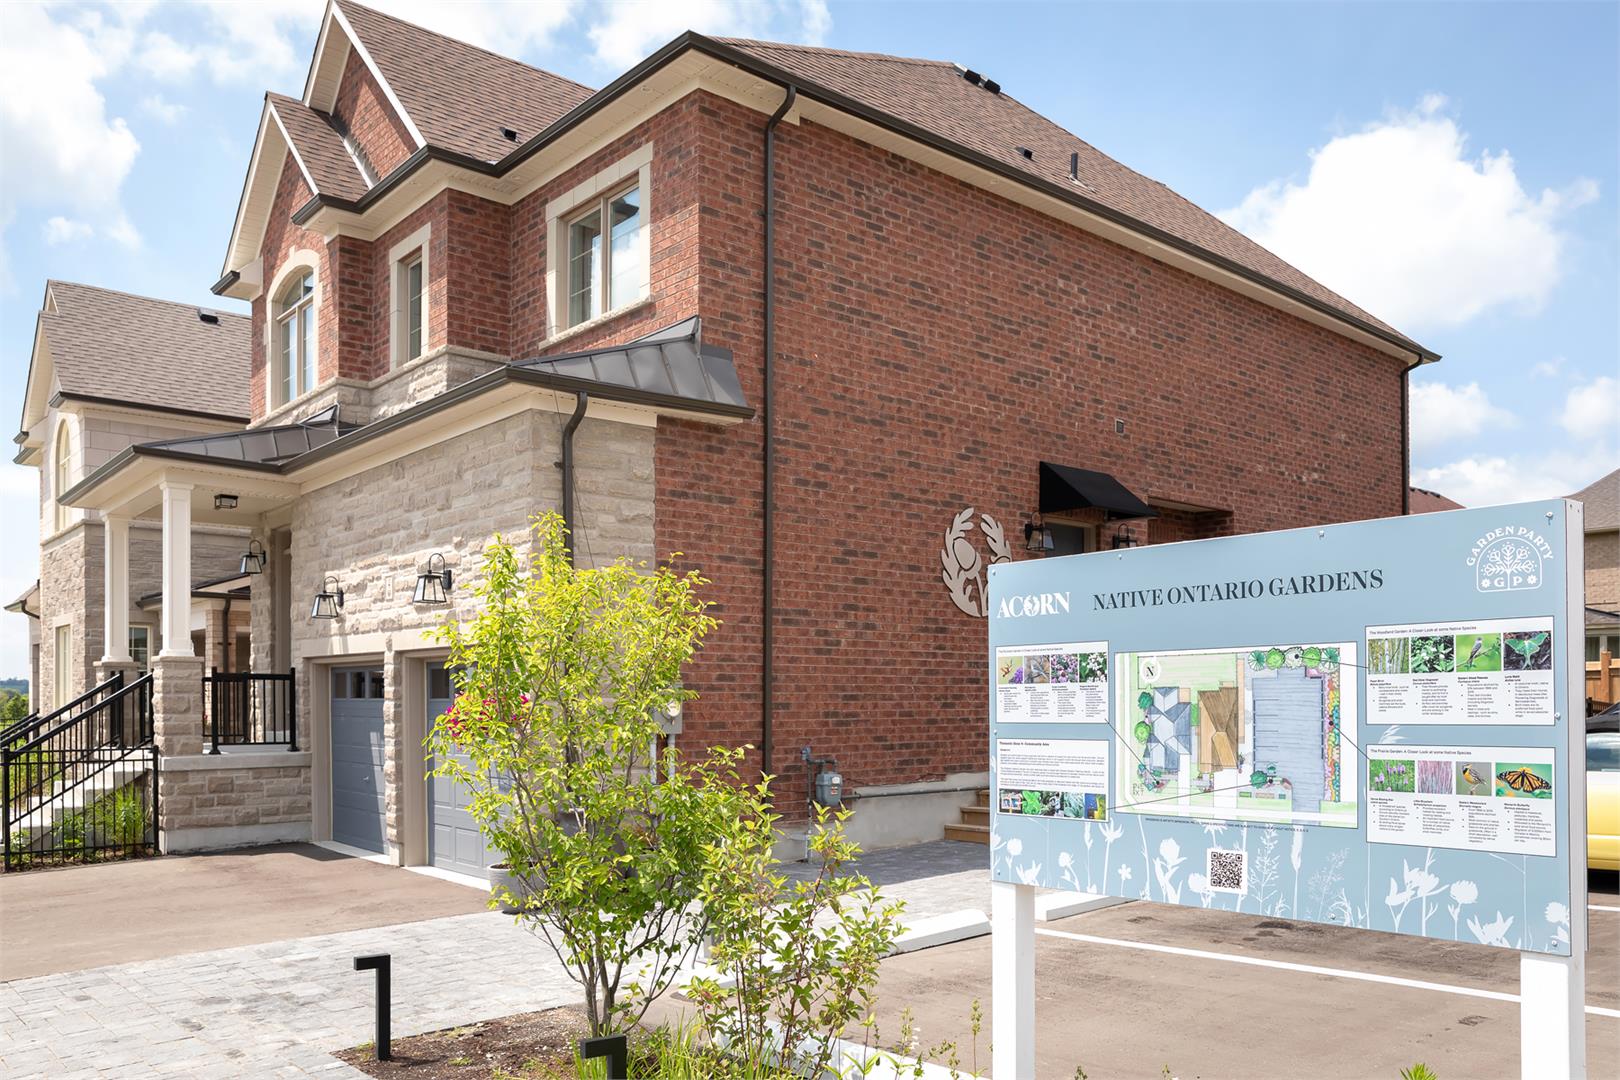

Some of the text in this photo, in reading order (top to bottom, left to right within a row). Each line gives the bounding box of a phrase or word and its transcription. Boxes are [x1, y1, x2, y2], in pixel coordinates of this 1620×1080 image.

[1466, 526, 1554, 566] GARDEN PARTY
[1093, 568, 1384, 611] NATIVE ONTARIO GARDENS
[1493, 576, 1522, 587] G P
[997, 592, 1071, 618] ACORN
